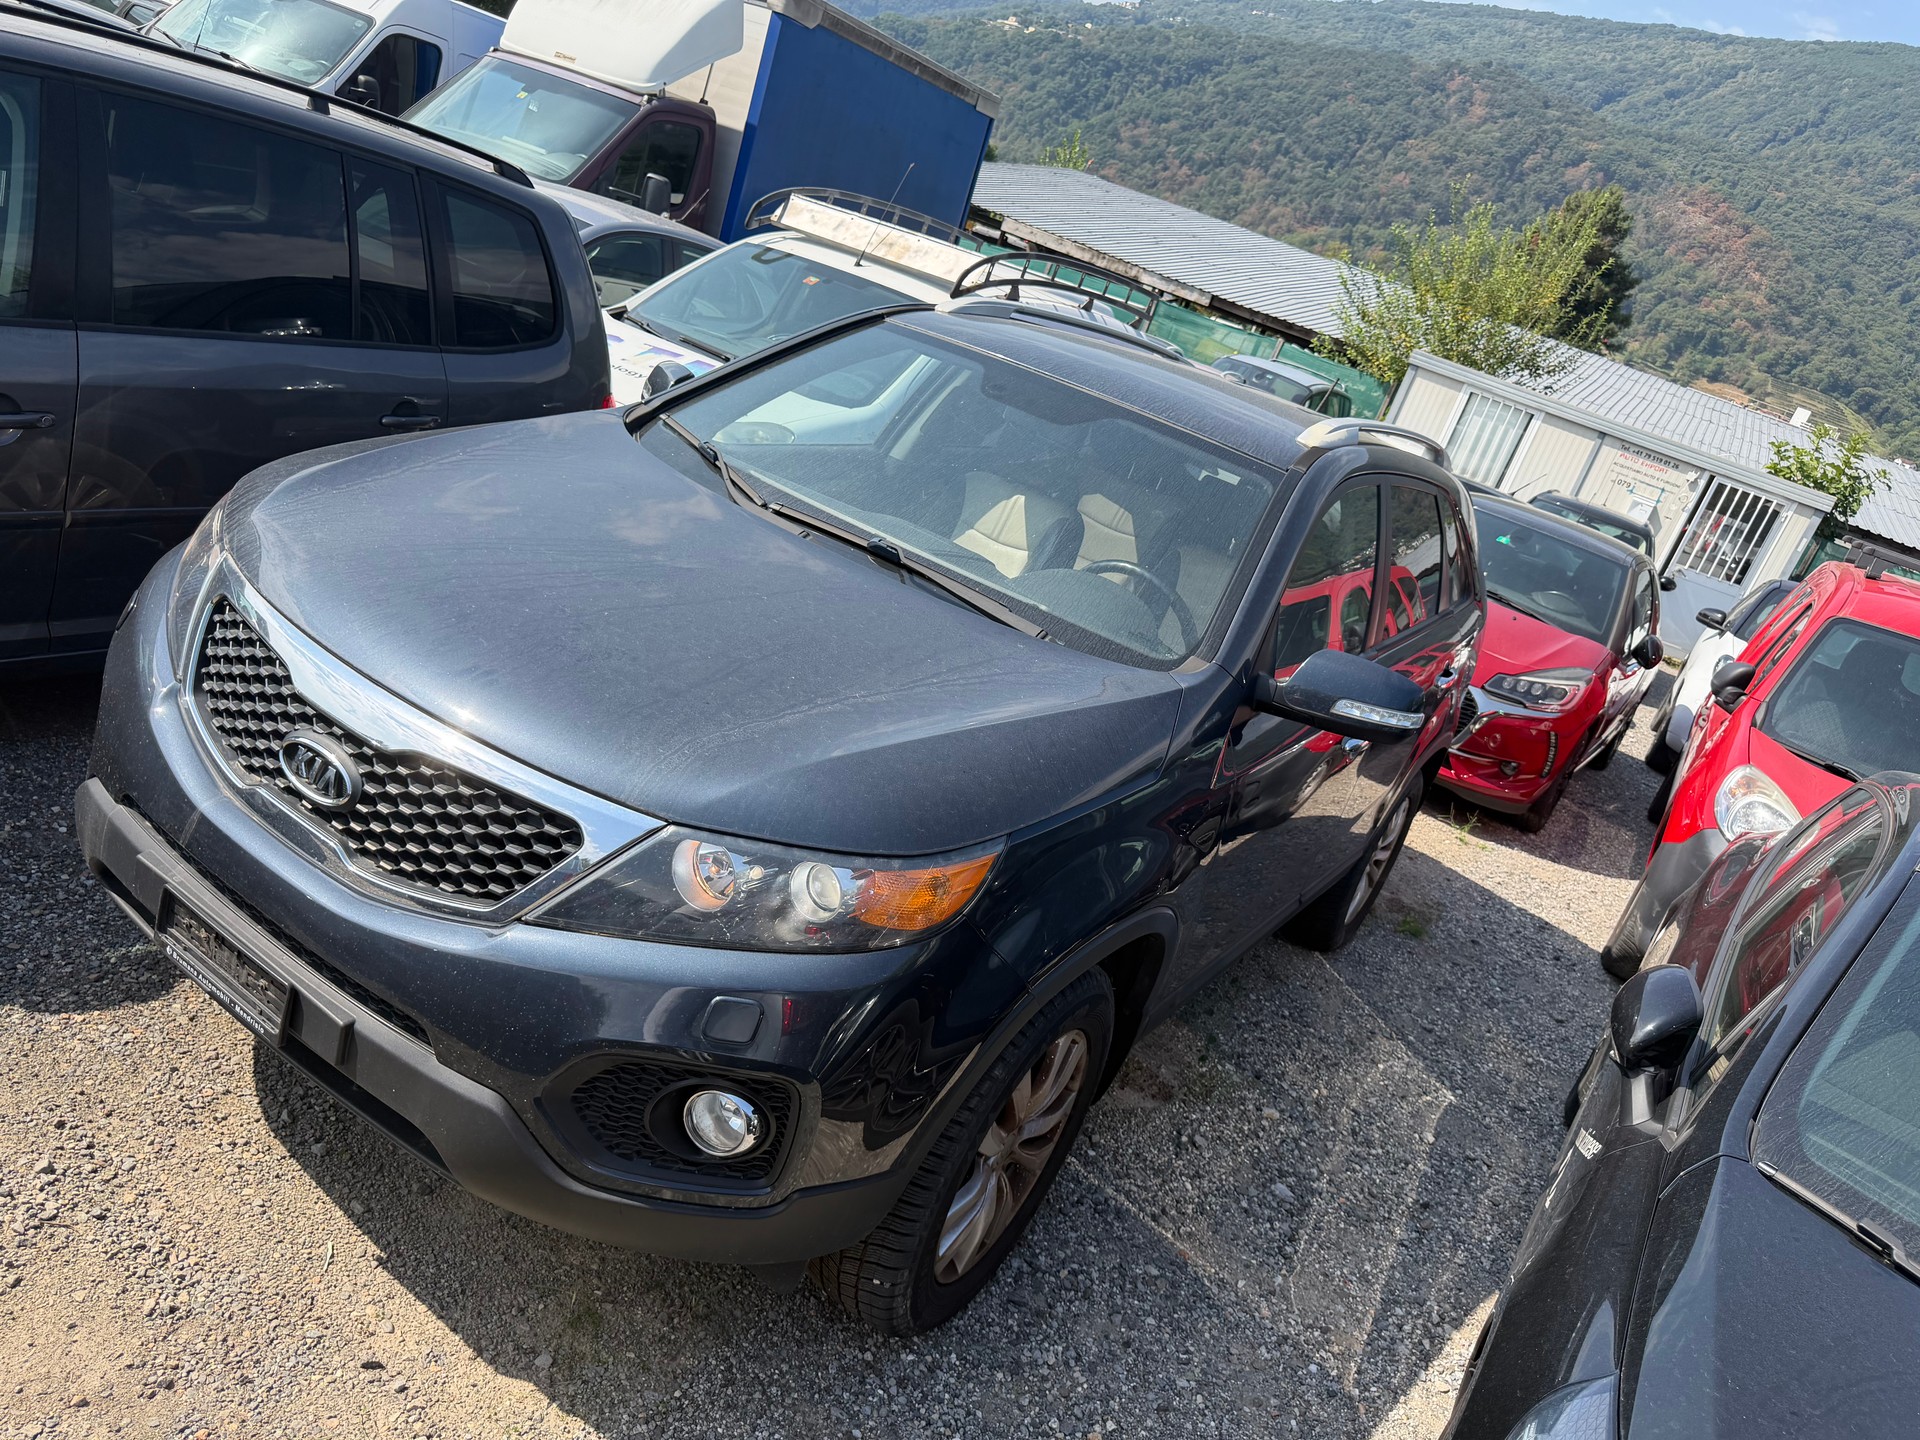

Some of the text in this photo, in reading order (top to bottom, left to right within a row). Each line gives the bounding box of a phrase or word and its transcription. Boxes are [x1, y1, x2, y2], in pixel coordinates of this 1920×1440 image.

[1619, 453, 1638, 464] AUTO
[1621, 444, 1631, 453] Tel.
[1632, 448, 1643, 456] +41
[1644, 452, 1651, 460] 79
[1652, 455, 1663, 465] 519
[1664, 459, 1671, 467] 01
[1617, 479, 1632, 489] 079
[291, 745, 336, 798] KIA
[198, 973, 230, 1004] Automobili
[235, 1005, 265, 1034] Mendrisio
